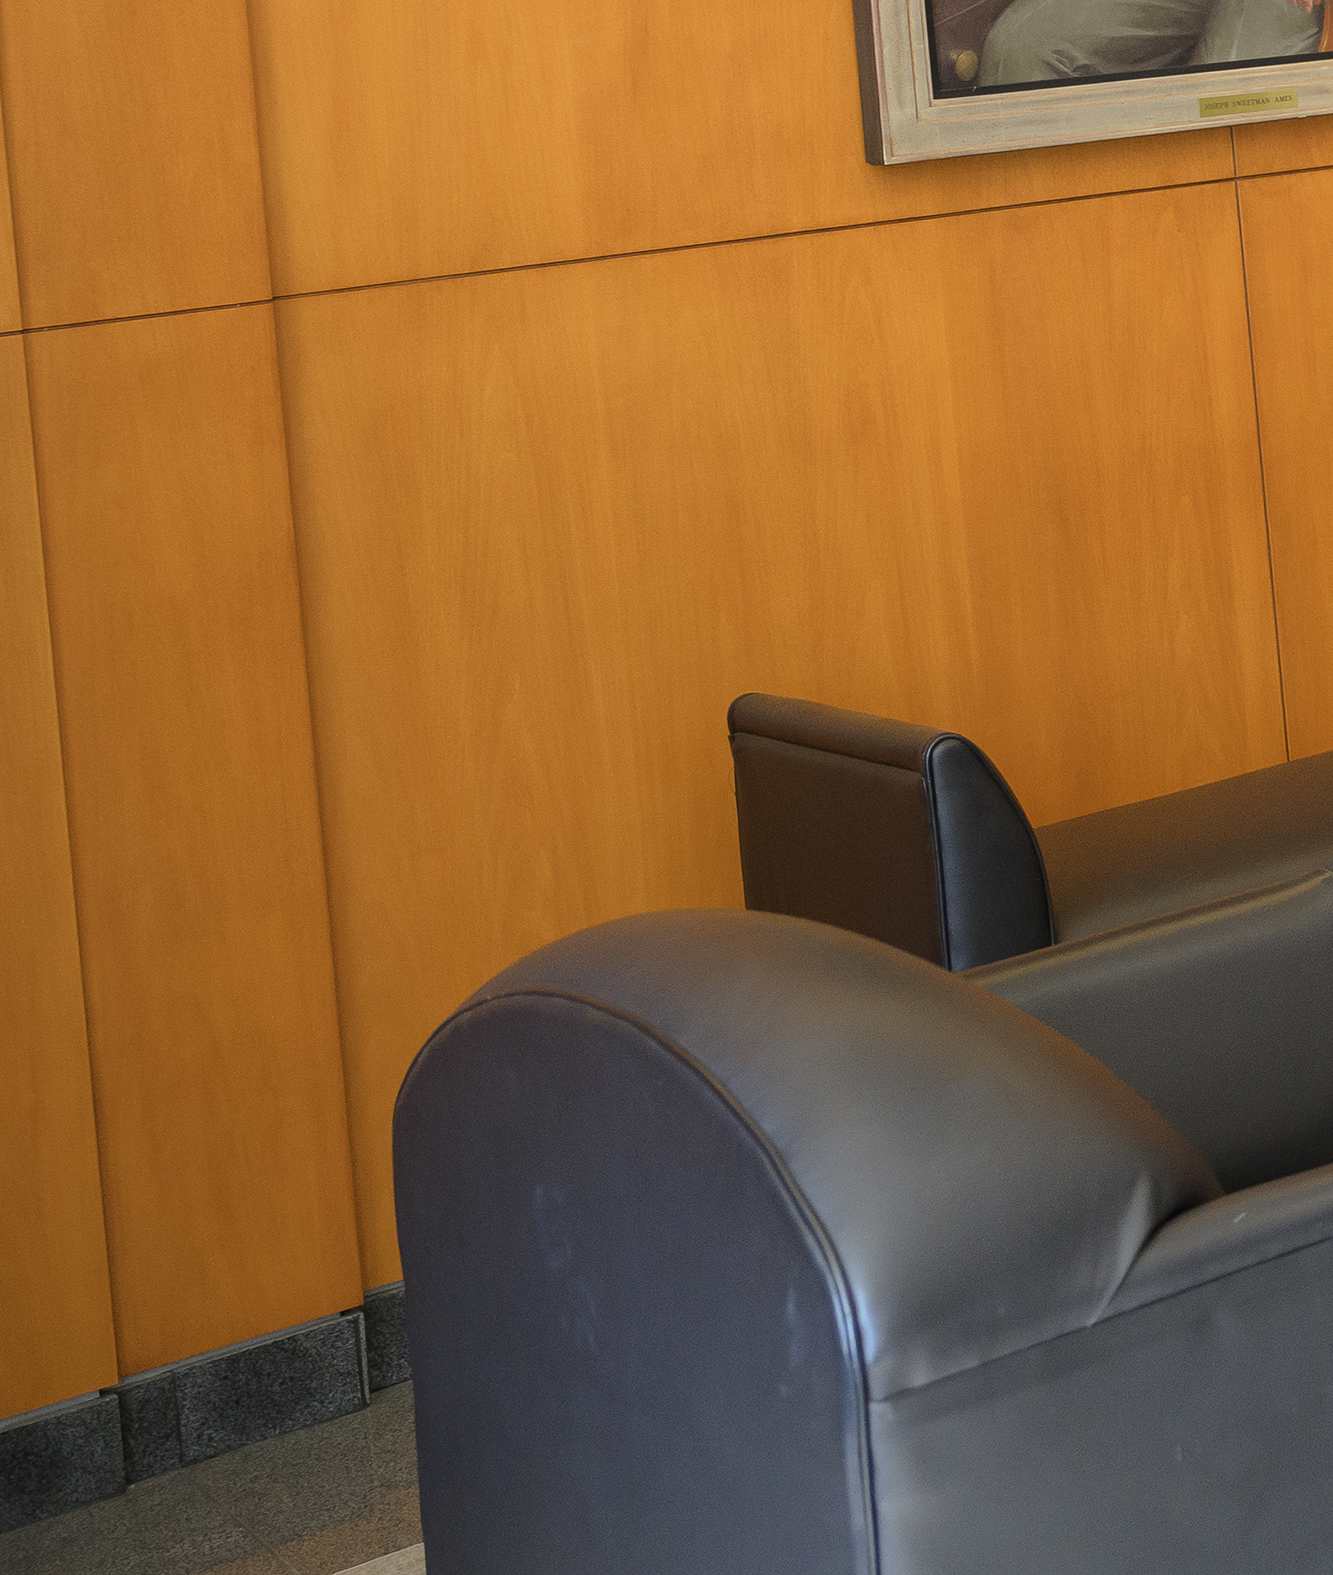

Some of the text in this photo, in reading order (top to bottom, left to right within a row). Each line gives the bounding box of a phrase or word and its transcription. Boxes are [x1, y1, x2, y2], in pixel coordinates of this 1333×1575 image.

[1204, 94, 1293, 111] JOSEPH SWEETMAN AMES
